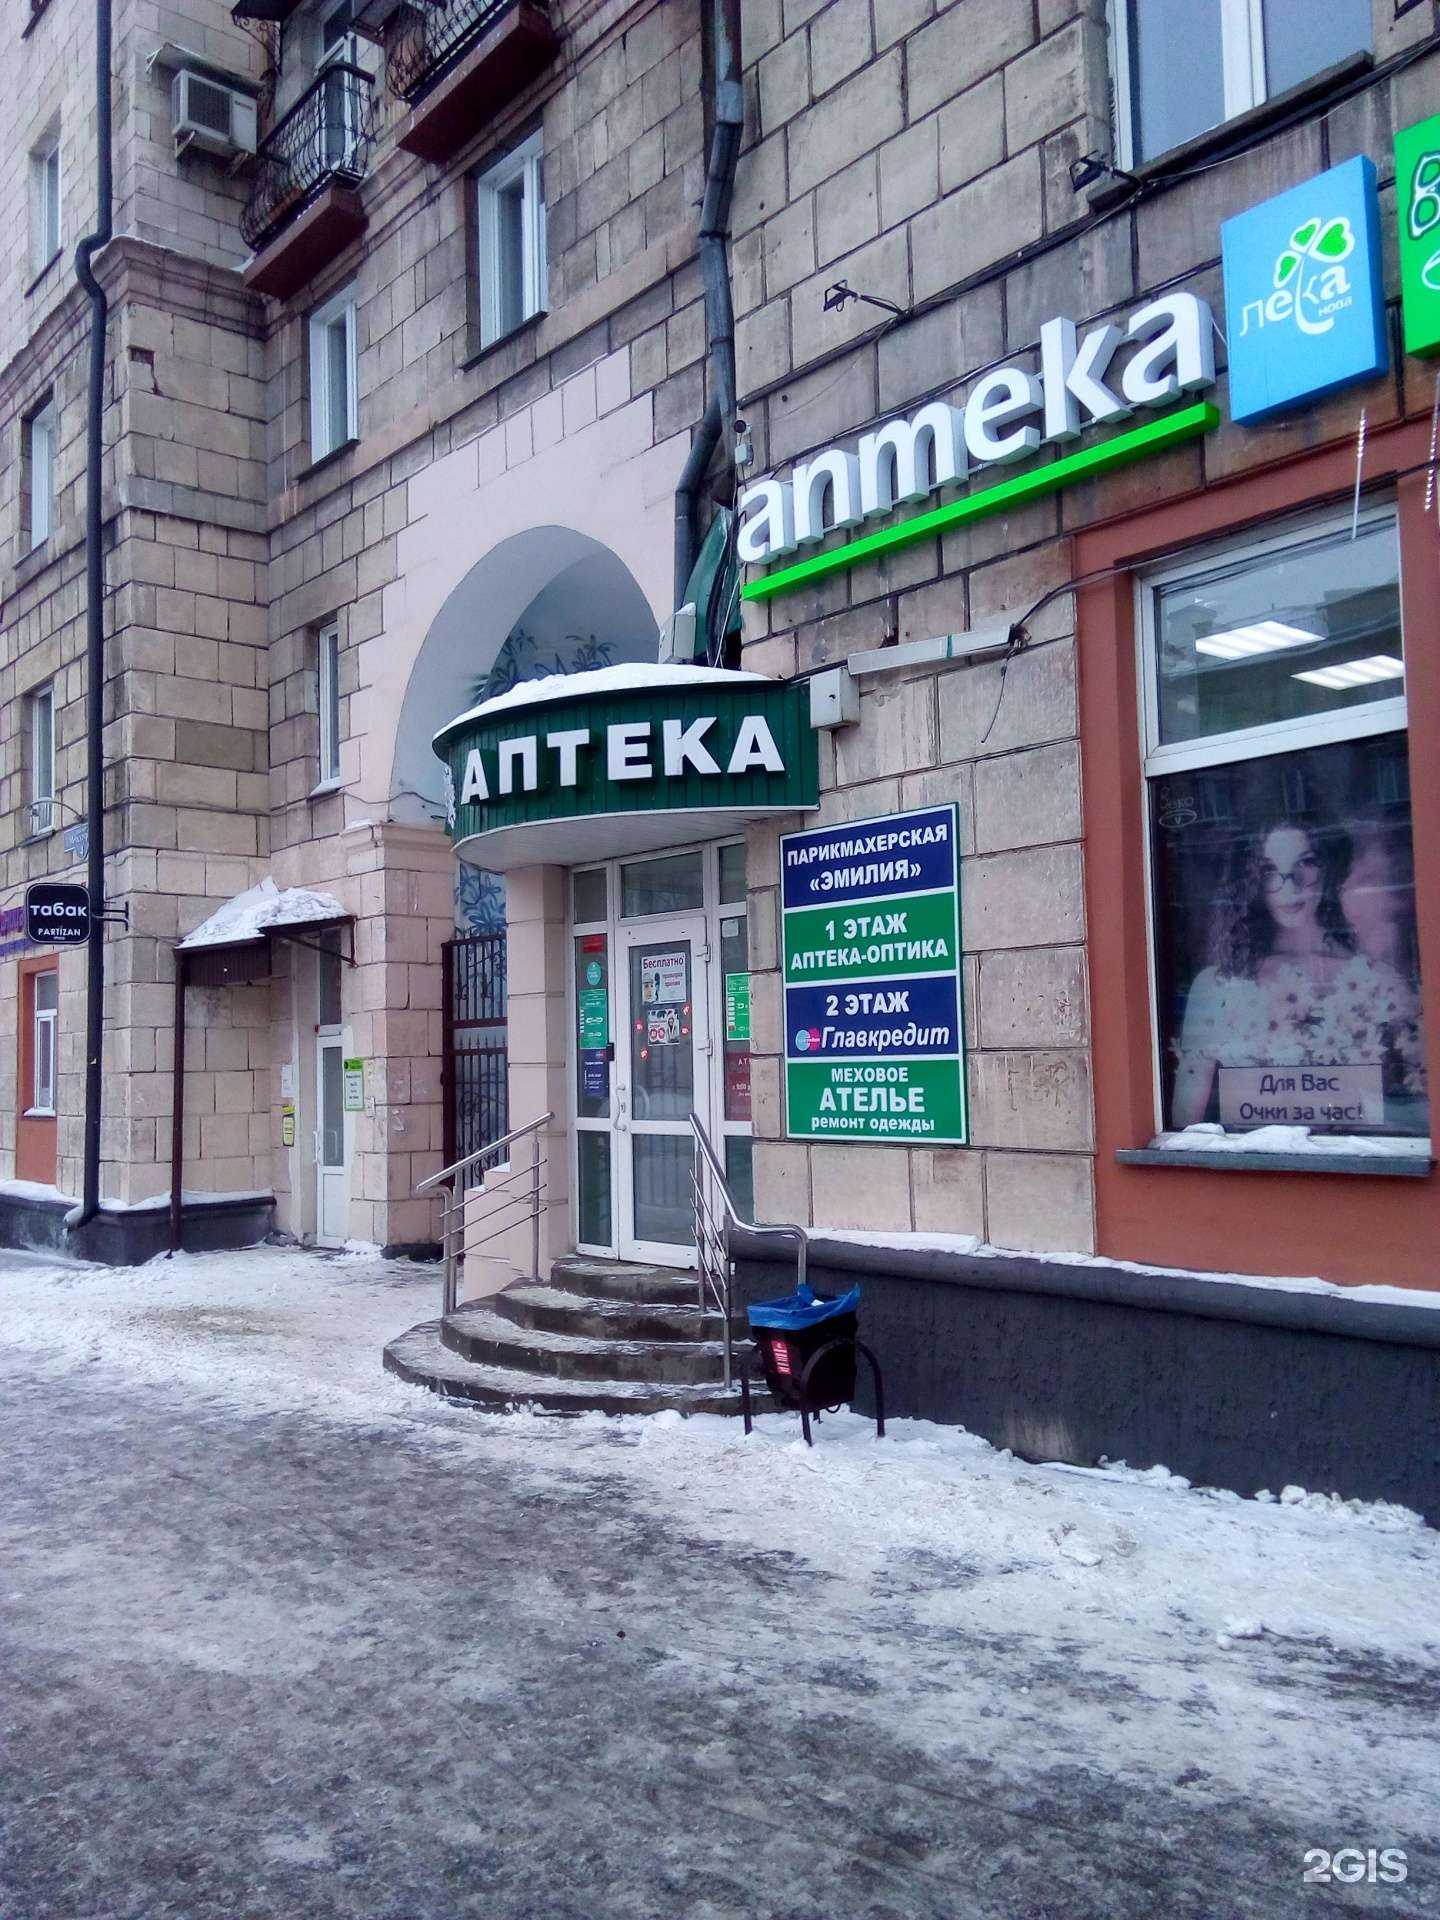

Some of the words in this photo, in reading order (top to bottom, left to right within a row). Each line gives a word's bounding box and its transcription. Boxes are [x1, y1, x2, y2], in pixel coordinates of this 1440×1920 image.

[737, 292, 1216, 564] аптека
[460, 715, 786, 805] АПТЕКА
[787, 823, 948, 867] ПАРИКМАХЕРСКАЯ
[810, 859, 922, 892] «ЭМИЛИЯ»
[30, 902, 87, 917] табак
[38, 928, 81, 936] PARTIZAN
[825, 920, 836, 941] 1
[843, 913, 907, 939] ЭТАЖ
[791, 938, 948, 971] АПТЕКА-ОПТИКА
[826, 995, 839, 1017] 2
[845, 991, 909, 1016] ЭТАЖ
[821, 1023, 950, 1052] Главкредит
[831, 1067, 908, 1083] МЕХОВОЕ
[1260, 1074, 1295, 1094] Для
[1301, 1074, 1339, 1091] Вас
[820, 1087, 926, 1113] АТЕЛЬЕ
[1240, 1102, 1287, 1120] Очки
[1293, 1106, 1314, 1120] за
[811, 1115, 865, 1131] ремонт
[869, 1117, 935, 1133] одежды
